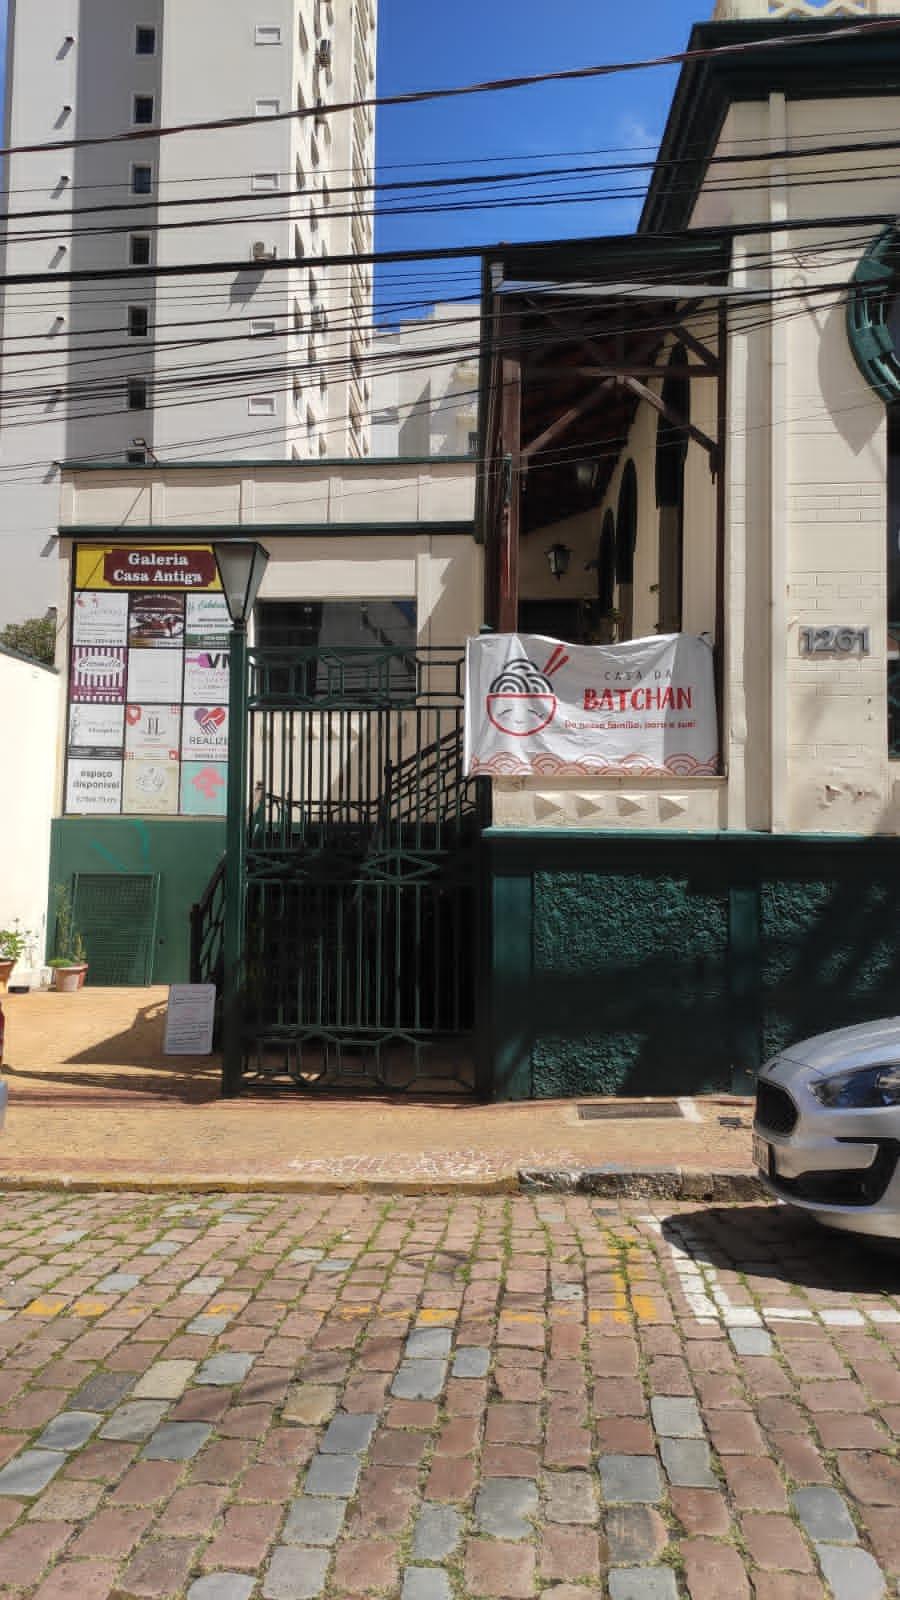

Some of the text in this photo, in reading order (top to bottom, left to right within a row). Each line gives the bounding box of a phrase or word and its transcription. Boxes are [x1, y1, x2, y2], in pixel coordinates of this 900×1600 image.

[128, 553, 188, 566] Galeria
[113, 569, 202, 584] Casa Antiga
[802, 626, 869, 652] 1261
[604, 671, 642, 681] CASA
[583, 687, 692, 712] BATCHAN
